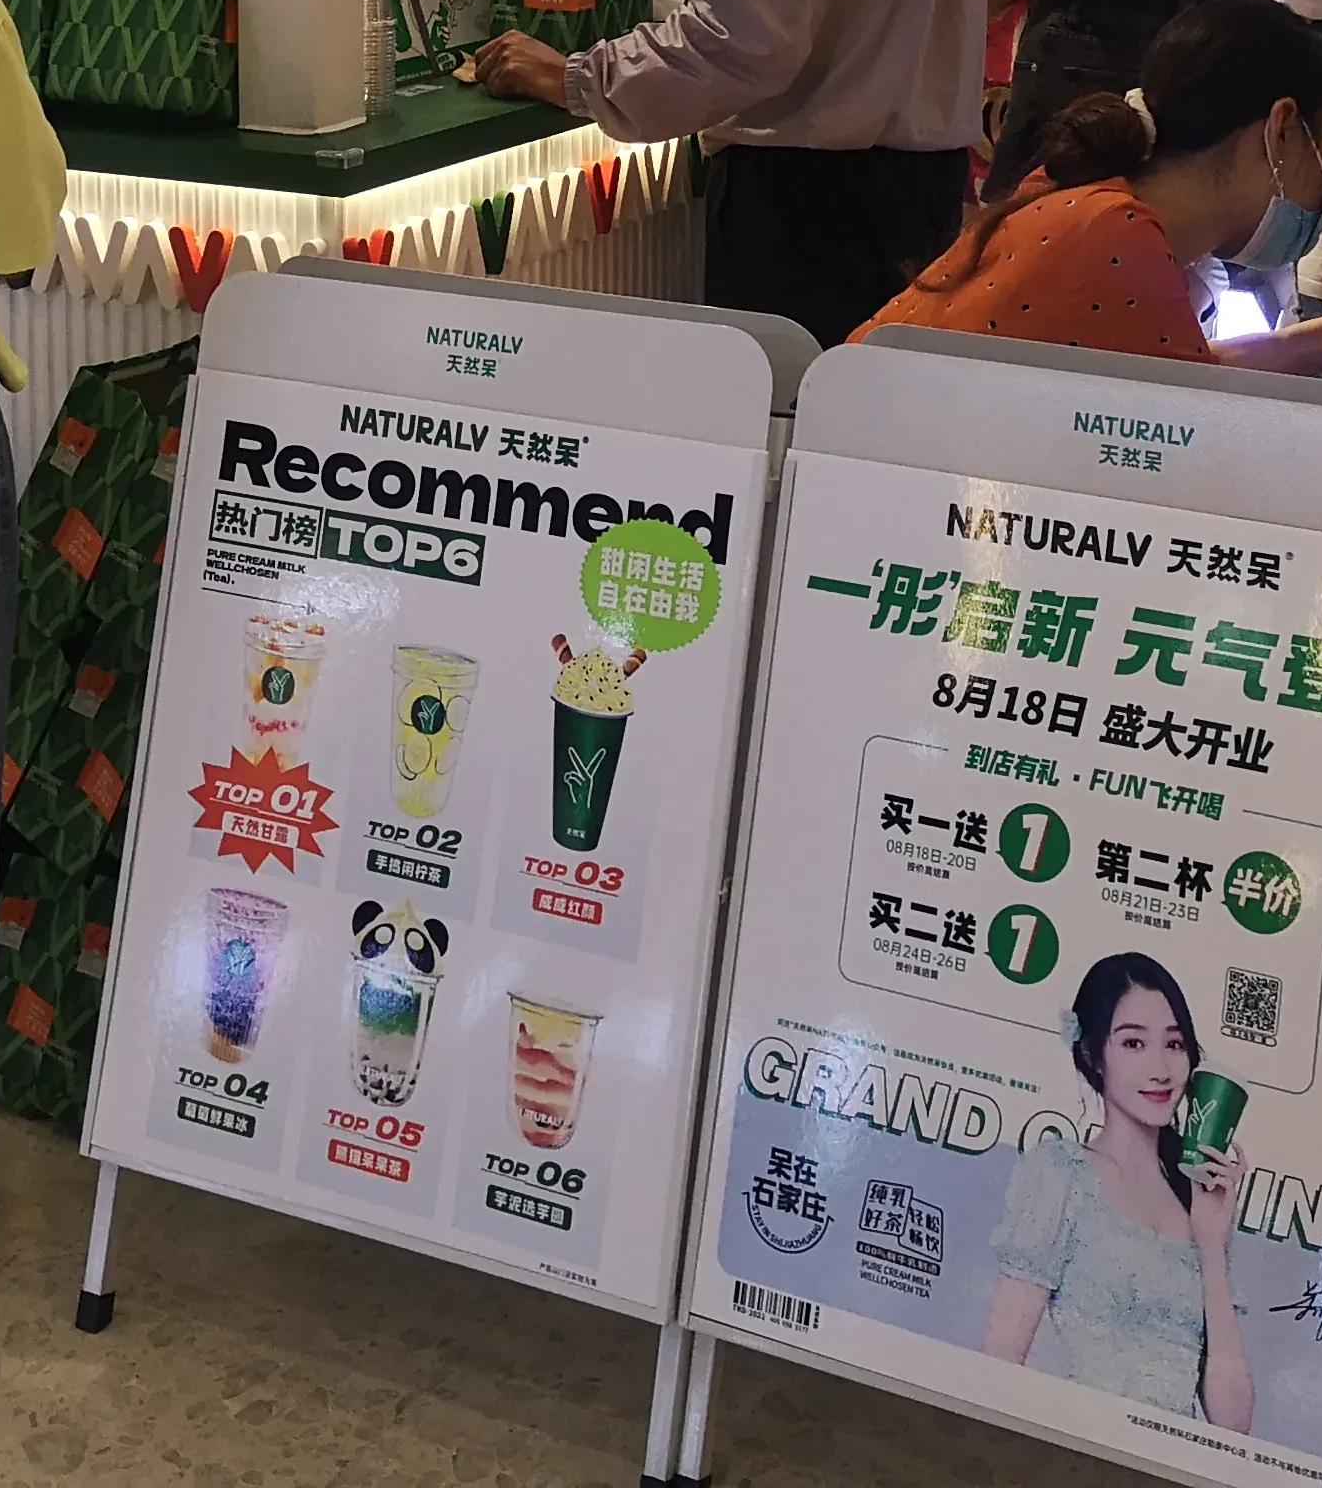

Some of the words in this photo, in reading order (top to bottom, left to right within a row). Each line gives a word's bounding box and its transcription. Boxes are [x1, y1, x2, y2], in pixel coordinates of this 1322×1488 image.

[426, 325, 524, 355] NATURALV
[445, 354, 499, 379] 天然呆
[339, 404, 490, 454] NATURALV
[497, 427, 581, 468] 天然呆
[1073, 410, 1196, 449] NATURALV
[1099, 443, 1164, 474] 天然呆
[215, 499, 320, 549] 热门榜
[324, 516, 482, 579] TOP6
[945, 502, 1154, 570] NATURALV
[1166, 536, 1283, 593] 天然呆
[205, 557, 280, 581] WELLCHOSEN
[206, 548, 237, 563] PURE
[236, 553, 276, 570] CREAM
[276, 560, 306, 575] MILK
[596, 579, 699, 624] 自在由我
[931, 673, 1089, 739] 8月18日
[1099, 701, 1277, 775] 盛大开业
[213, 780, 265, 806] TOP
[270, 784, 319, 820] 01
[963, 743, 1061, 788] 到店有礼
[1088, 767, 1226, 822] FUN飞开喝
[367, 820, 410, 842] TOP
[415, 824, 464, 855] 02
[879, 792, 989, 855] 买一送
[524, 856, 568, 879] TOP
[573, 860, 626, 892] 03
[885, 838, 977, 872] 08月18日-20日
[1095, 838, 1215, 904] 第二杯
[1226, 866, 1303, 919] 半价
[868, 890, 977, 955] 买二送
[1100, 886, 1201, 923] 08月21日-23日
[178, 1066, 219, 1090] TOP
[223, 1072, 271, 1105] 04
[743, 1036, 1003, 1156] GRAND
[327, 1108, 370, 1132] TOP
[375, 1114, 425, 1147] 05
[485, 1152, 531, 1178] TOP
[535, 1160, 587, 1194] 06
[766, 1145, 820, 1188] 呆在
[751, 1175, 828, 1224] 石家庄
[859, 1270, 915, 1294] WELLCHOSEN
[914, 1286, 931, 1299] TEA
[861, 1258, 883, 1273] PURE
[883, 1264, 912, 1281] CREAM
[912, 1274, 933, 1289] MILK
